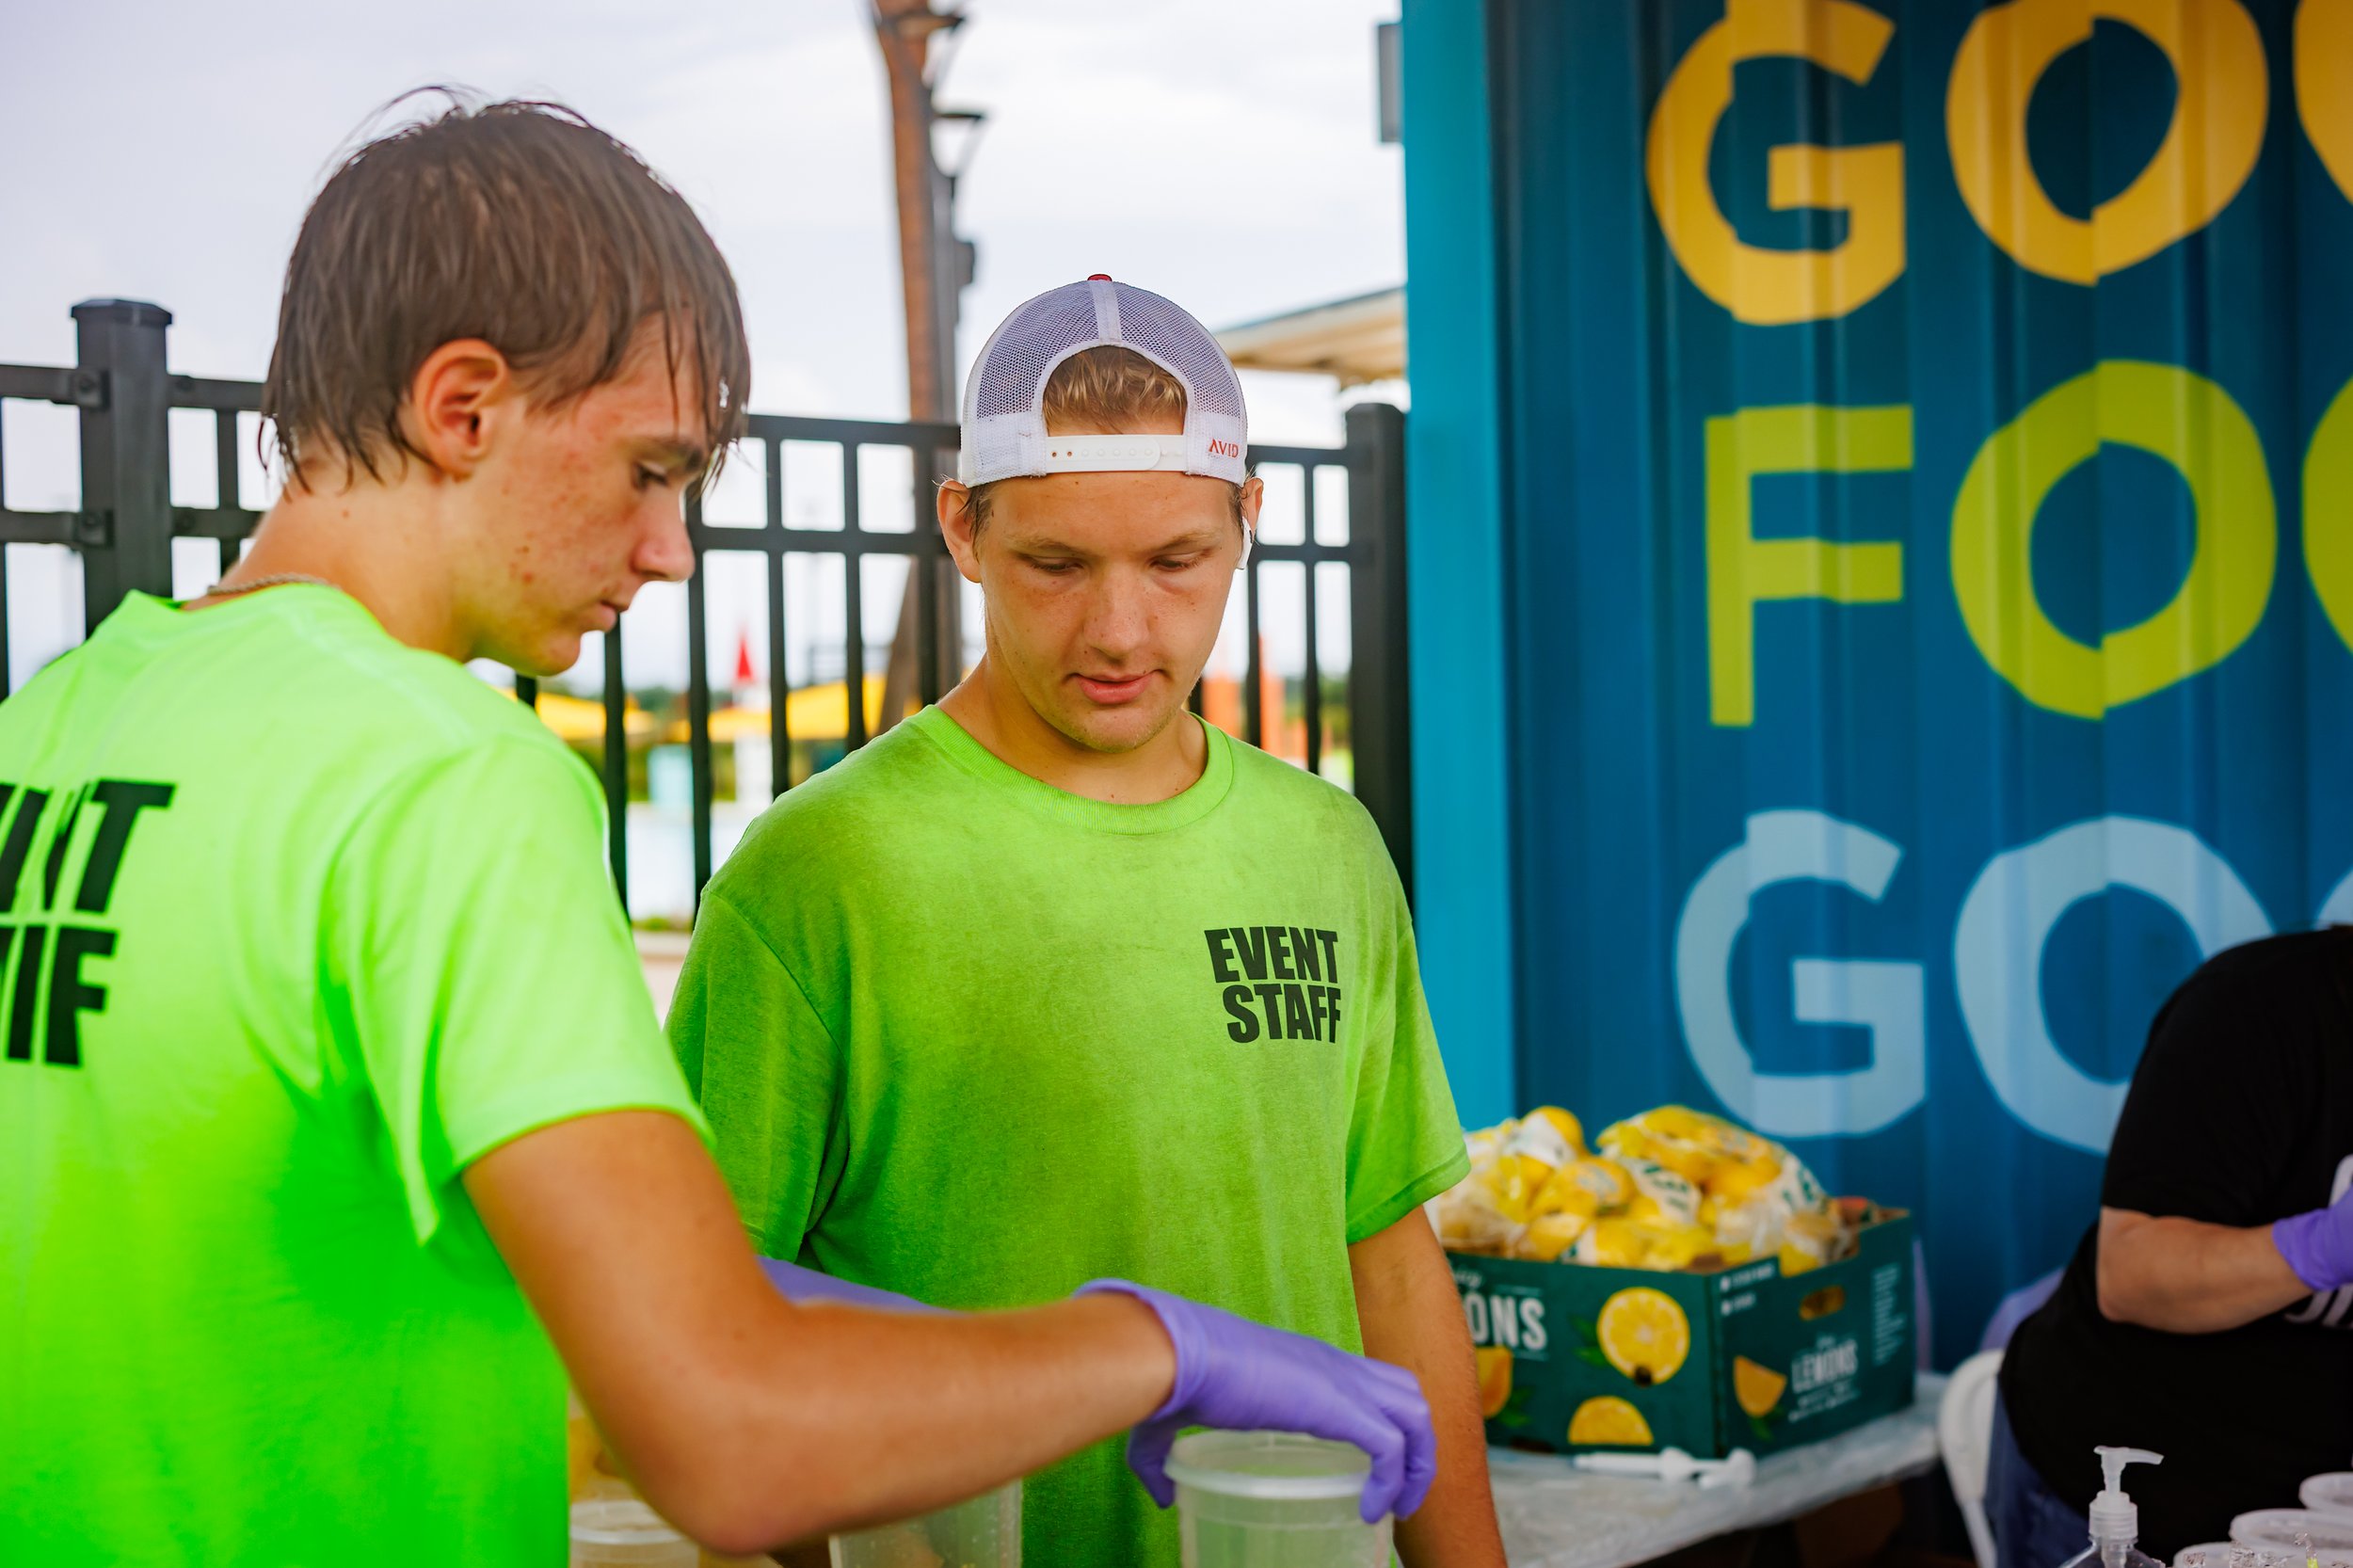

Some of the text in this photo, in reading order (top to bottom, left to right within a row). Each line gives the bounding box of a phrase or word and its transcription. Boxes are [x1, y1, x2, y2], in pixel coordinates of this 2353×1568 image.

[1646, 0, 2353, 326] GO
[1209, 438, 1239, 458] AVID
[1705, 359, 2353, 725] FO
[1204, 925, 1338, 984] EVENT
[1673, 808, 2353, 1156] GO
[1222, 983, 1341, 1044] STAFF
[1464, 1290, 1548, 1351] ONS
[1791, 1336, 1859, 1395] LEMONS
